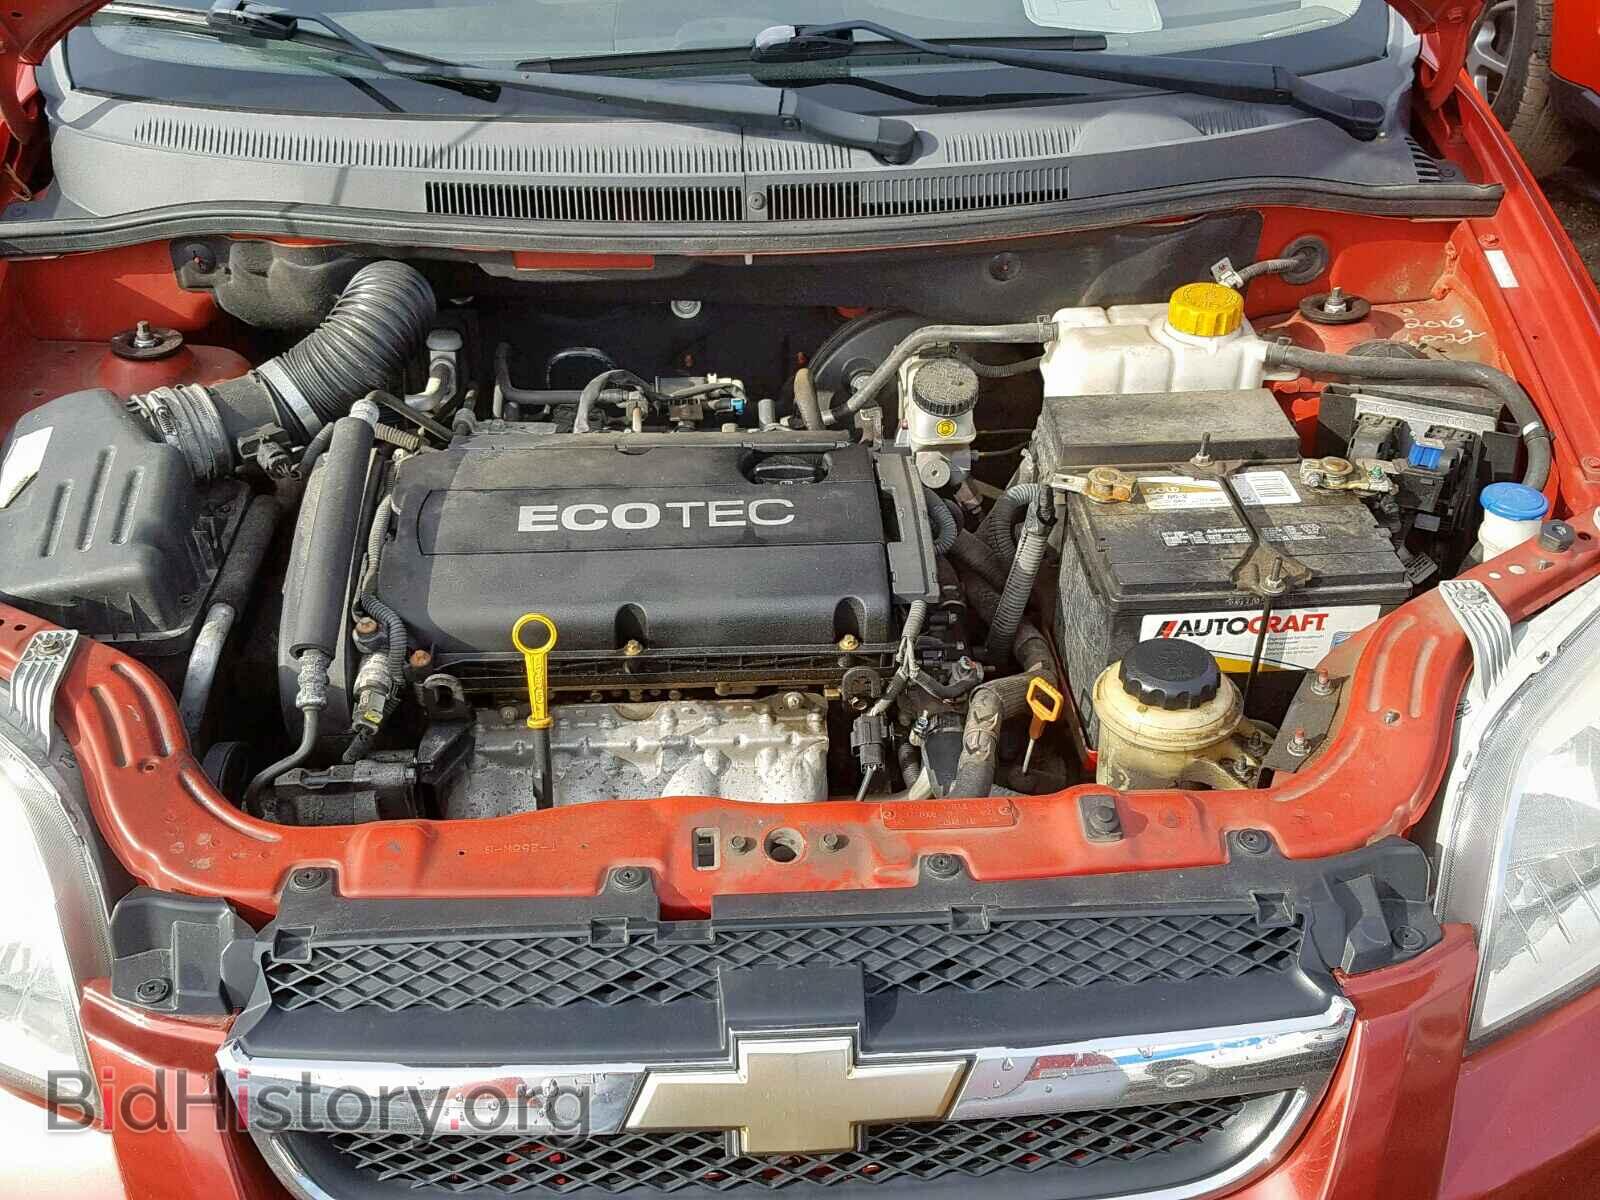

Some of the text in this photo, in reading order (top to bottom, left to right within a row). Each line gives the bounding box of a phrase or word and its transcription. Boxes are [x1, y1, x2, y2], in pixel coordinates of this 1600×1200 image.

[1146, 486, 1180, 494] GOLD
[517, 498, 796, 533] ECOTEC
[1173, 613, 1330, 638] AUTOCRAFT
